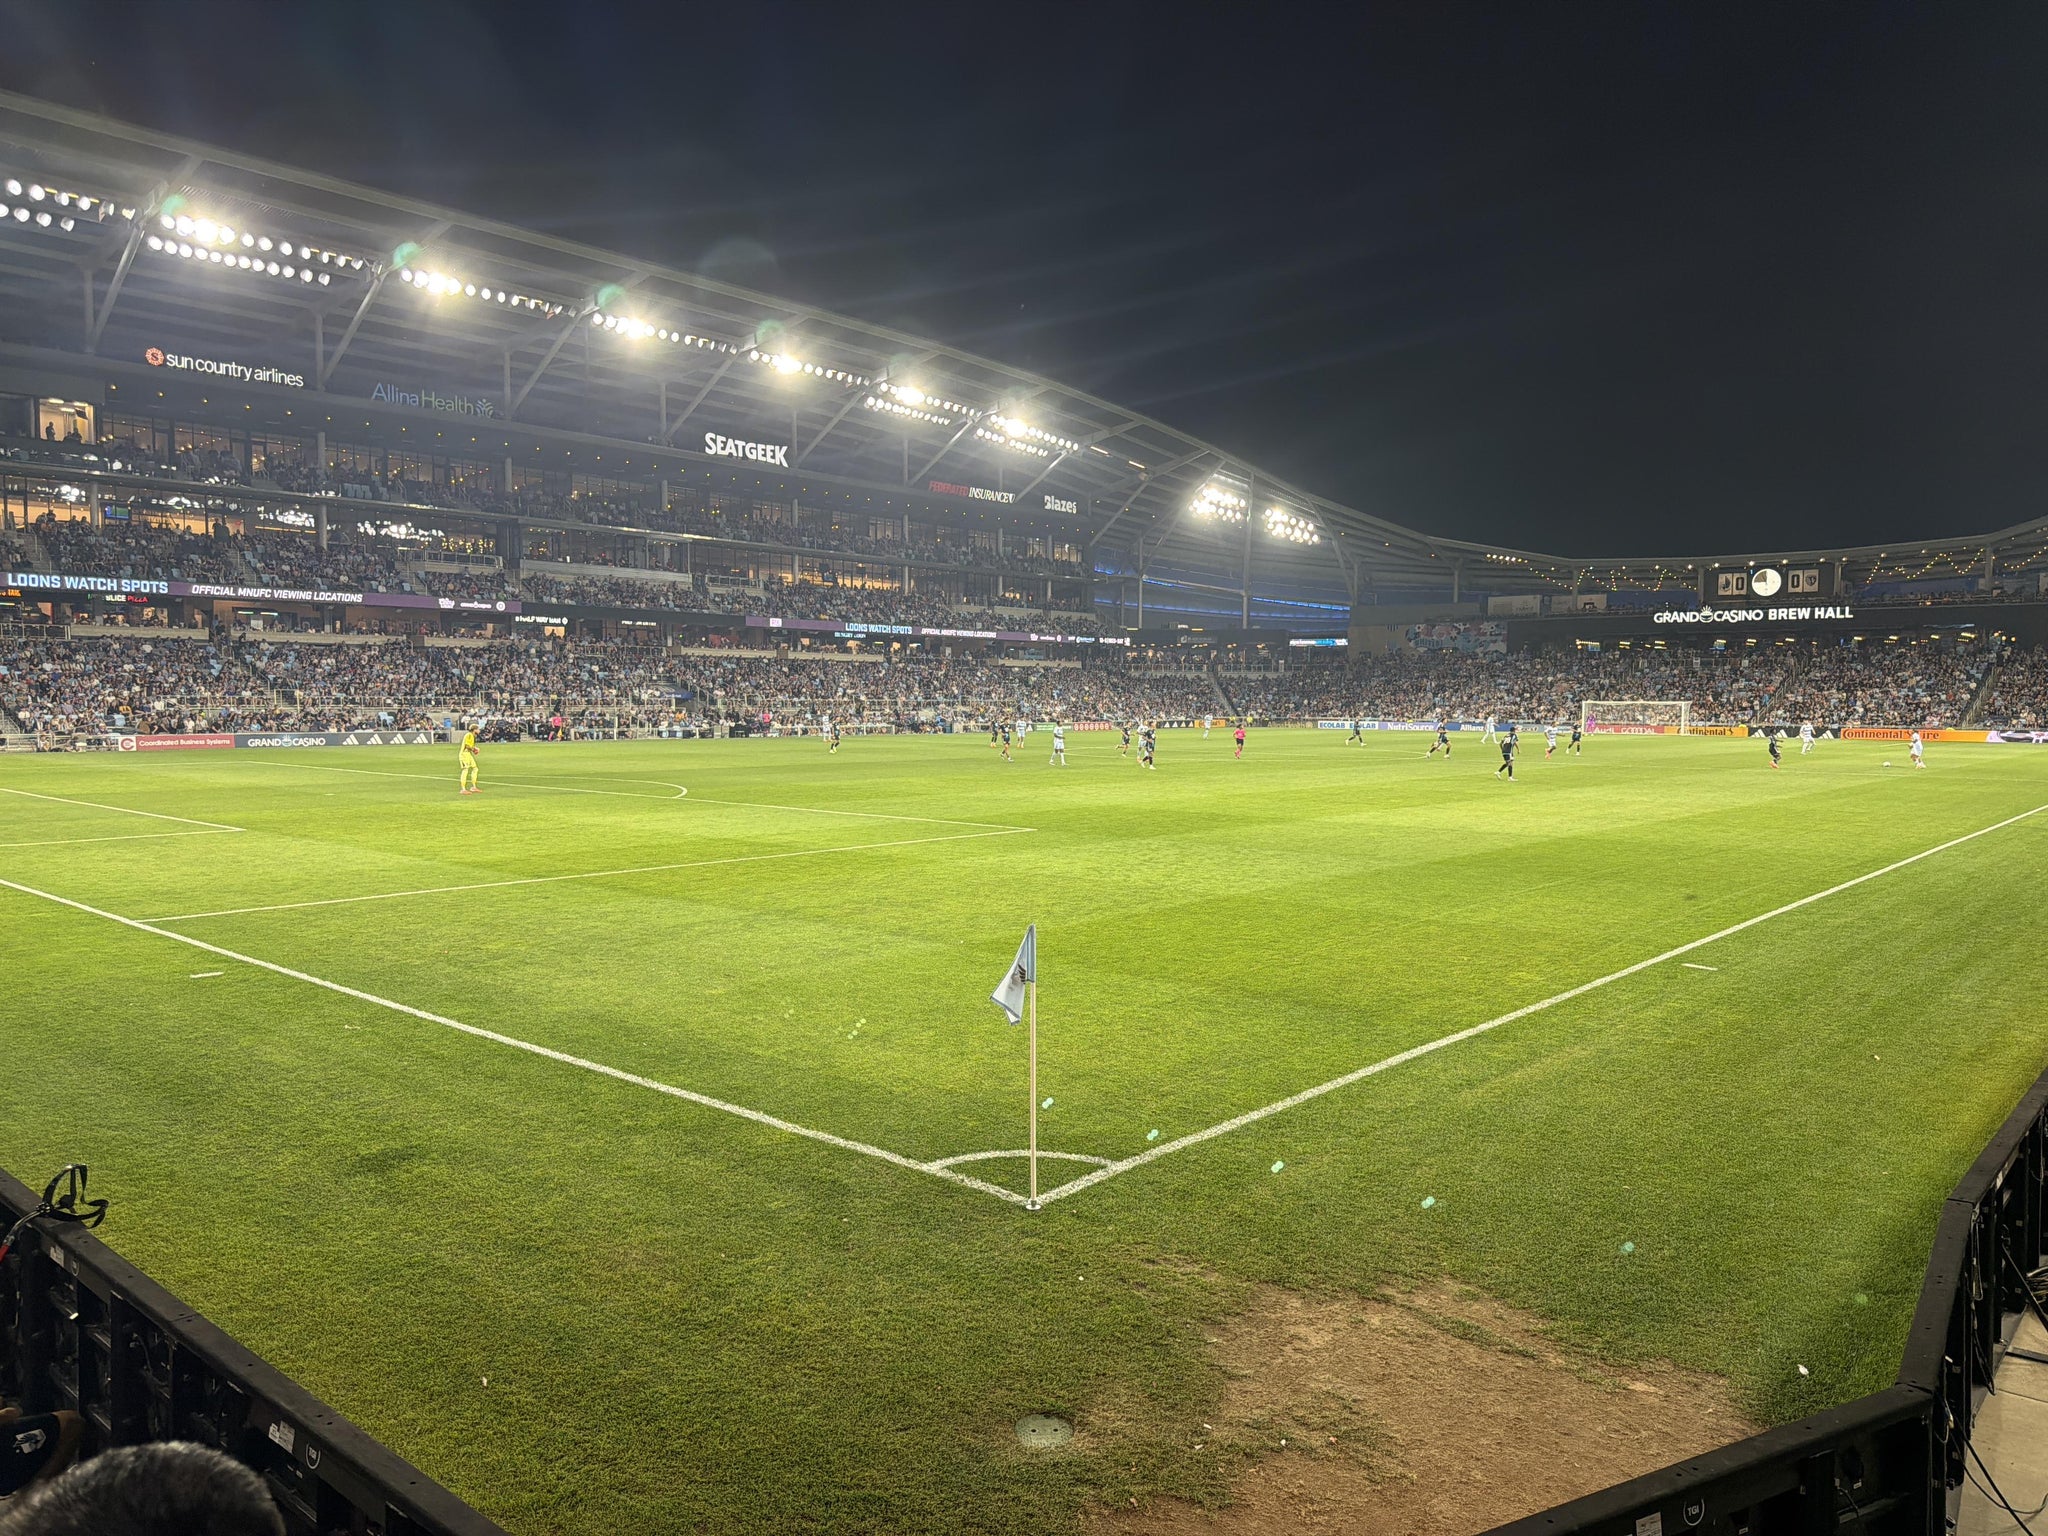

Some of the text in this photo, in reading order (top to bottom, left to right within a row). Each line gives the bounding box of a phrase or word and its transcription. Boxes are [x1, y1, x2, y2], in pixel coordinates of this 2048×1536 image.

[166, 353, 304, 387] sun country airlines
[371, 381, 474, 415] Allina Health
[704, 432, 789, 468] SEATGEEK
[968, 486, 1010, 503] INSURANCE
[7, 573, 169, 594] LOONS WATCH SPOTS
[1735, 576, 1745, 591] 0
[1791, 573, 1800, 589] 0
[191, 584, 363, 603] OFFICIAL MNUFC VIEWING LOCATIONS
[1653, 606, 1854, 624] GRAND CASINO BREW HALL
[845, 622, 913, 635] LOONS WATCH SPOTS
[1387, 722, 1434, 731] NutriSource
[1460, 723, 1485, 732] Allianz
[1594, 726, 1615, 735] Audi
[1676, 727, 1727, 736] Cntinental
[247, 737, 326, 747] GRAND CASINO
[1842, 729, 1903, 740] Continental
[138, 739, 179, 747] Coordinated
[206, 738, 231, 746] Systems
